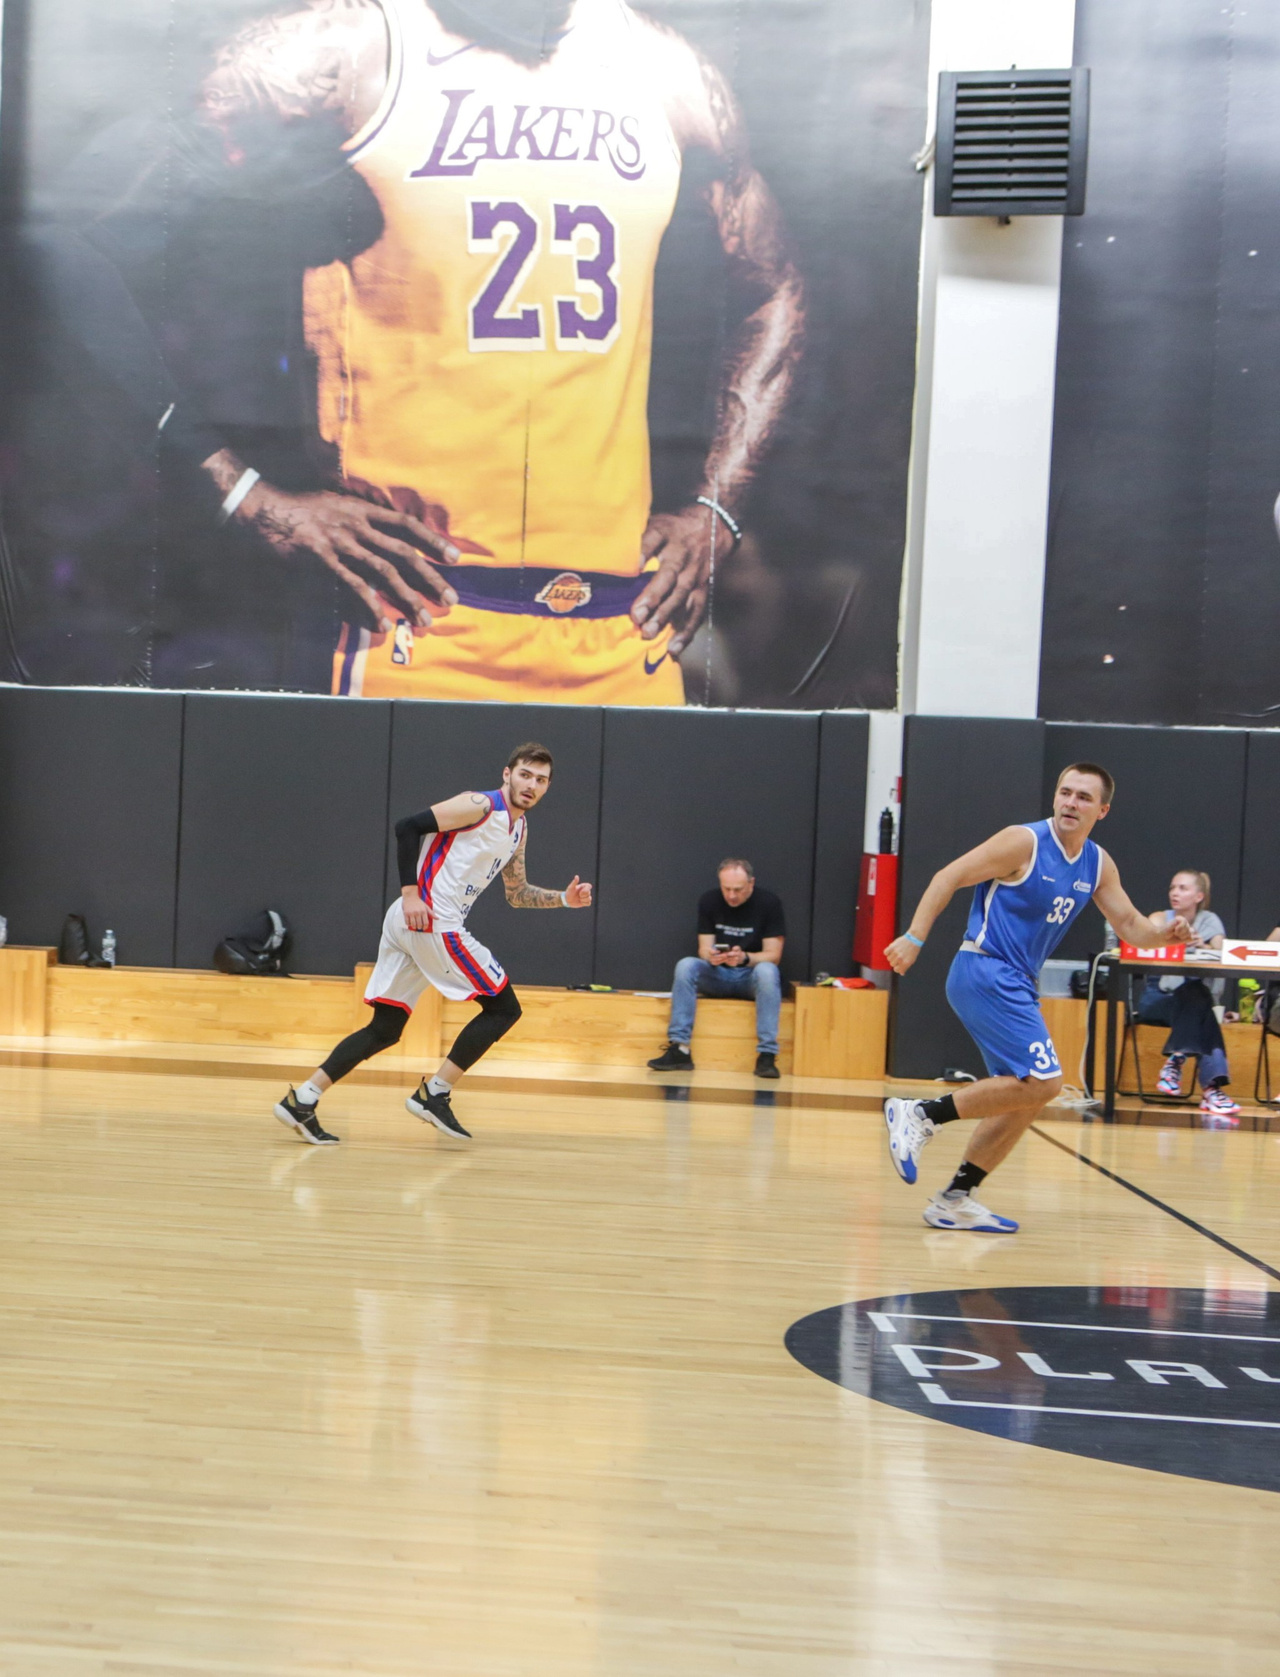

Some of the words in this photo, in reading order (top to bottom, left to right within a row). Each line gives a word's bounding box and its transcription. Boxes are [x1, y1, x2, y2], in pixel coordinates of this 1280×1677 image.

[409, 88, 647, 181] LAKERS
[467, 199, 621, 353] 23
[1046, 896, 1075, 925] 33
[1029, 1038, 1058, 1070] 33
